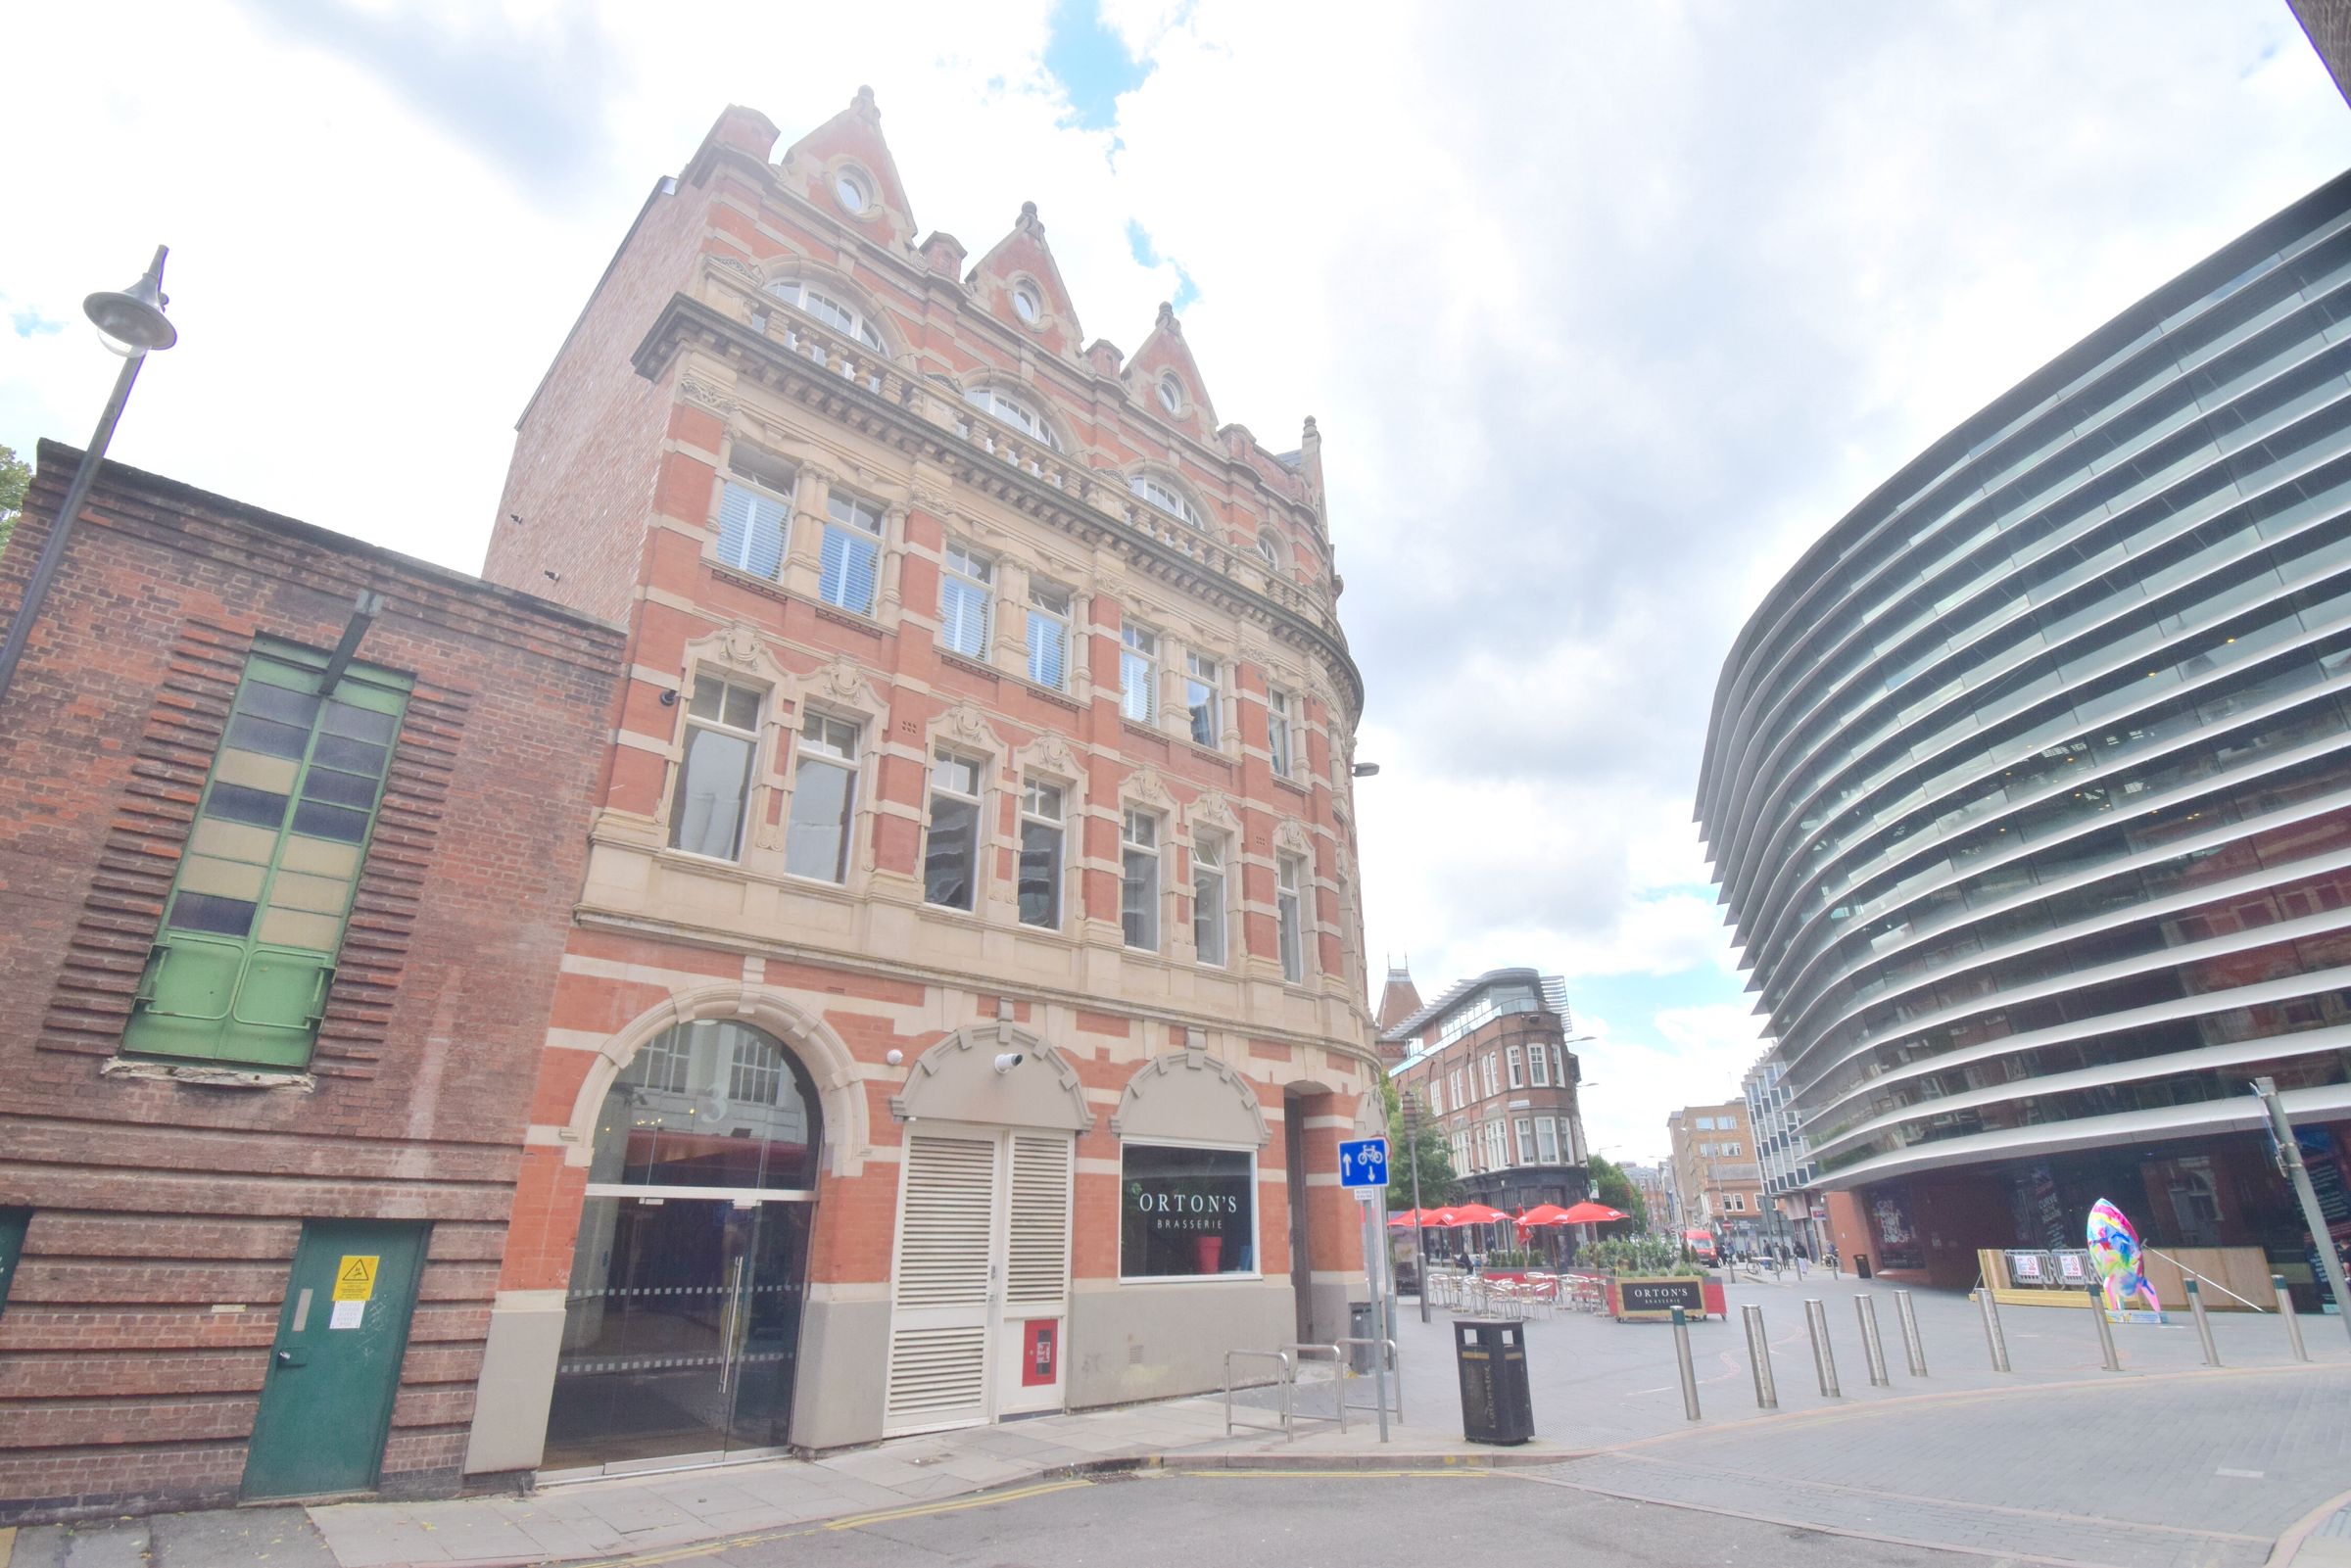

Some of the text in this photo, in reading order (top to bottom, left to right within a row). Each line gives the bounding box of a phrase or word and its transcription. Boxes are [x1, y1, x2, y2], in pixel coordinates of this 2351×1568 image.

[701, 1081, 728, 1123] 3
[1139, 1193, 1237, 1212] ORTON'S
[1157, 1219, 1223, 1229] BRASSERIE
[1634, 1288, 1688, 1298] ORTON'S
